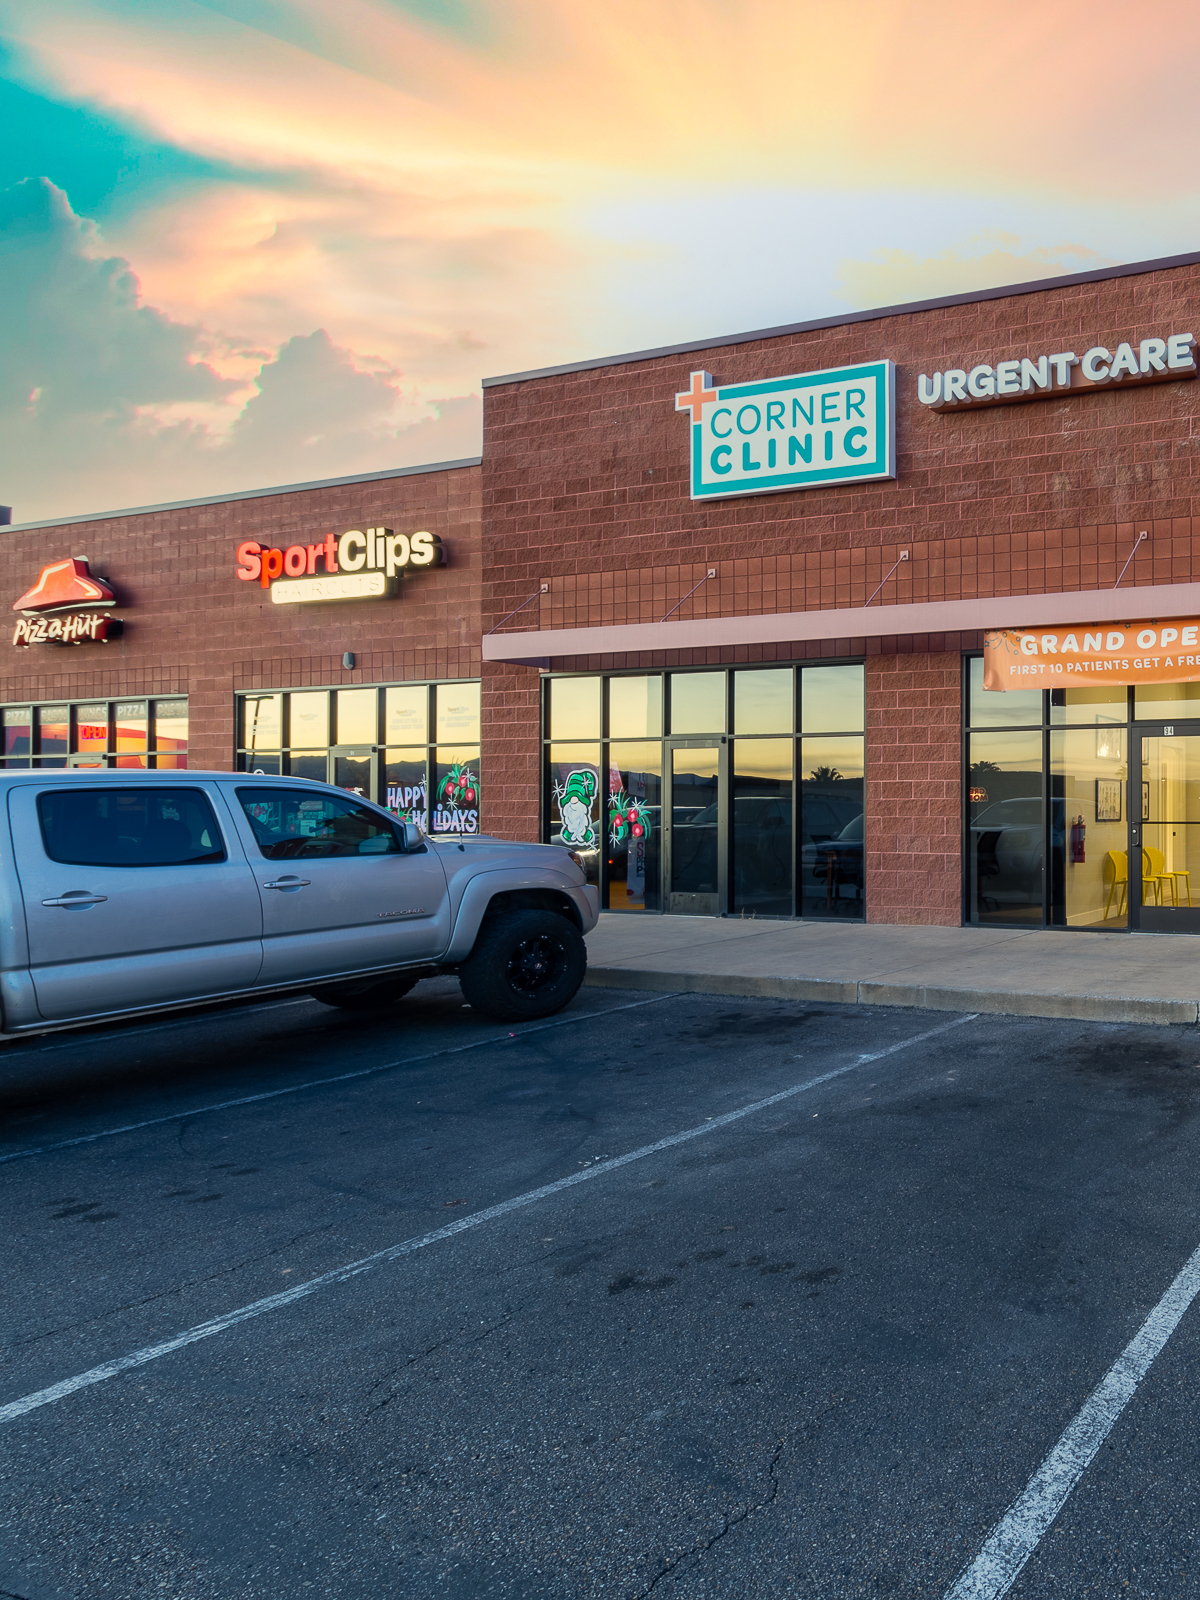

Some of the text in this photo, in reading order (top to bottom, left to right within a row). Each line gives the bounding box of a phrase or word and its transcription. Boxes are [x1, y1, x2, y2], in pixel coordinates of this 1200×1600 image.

[917, 333, 1198, 406] URGENT CARE
[710, 388, 867, 439] CORNER
[710, 426, 868, 475] CLINIC
[276, 576, 381, 599] HAIRCUTS
[1020, 631, 1125, 656] GRAND
[1010, 664, 1046, 676] FIRST
[1049, 663, 1063, 674] 10
[1067, 659, 1130, 673] PATIENTS
[1133, 657, 1160, 669] GET
[1164, 656, 1174, 667] A
[5, 710, 31, 722] PIZZA
[117, 704, 146, 717] PIZZA
[83, 726, 106, 739] OPEN
[387, 785, 427, 809] HAPPY
[375, 907, 426, 918] TACOMA
